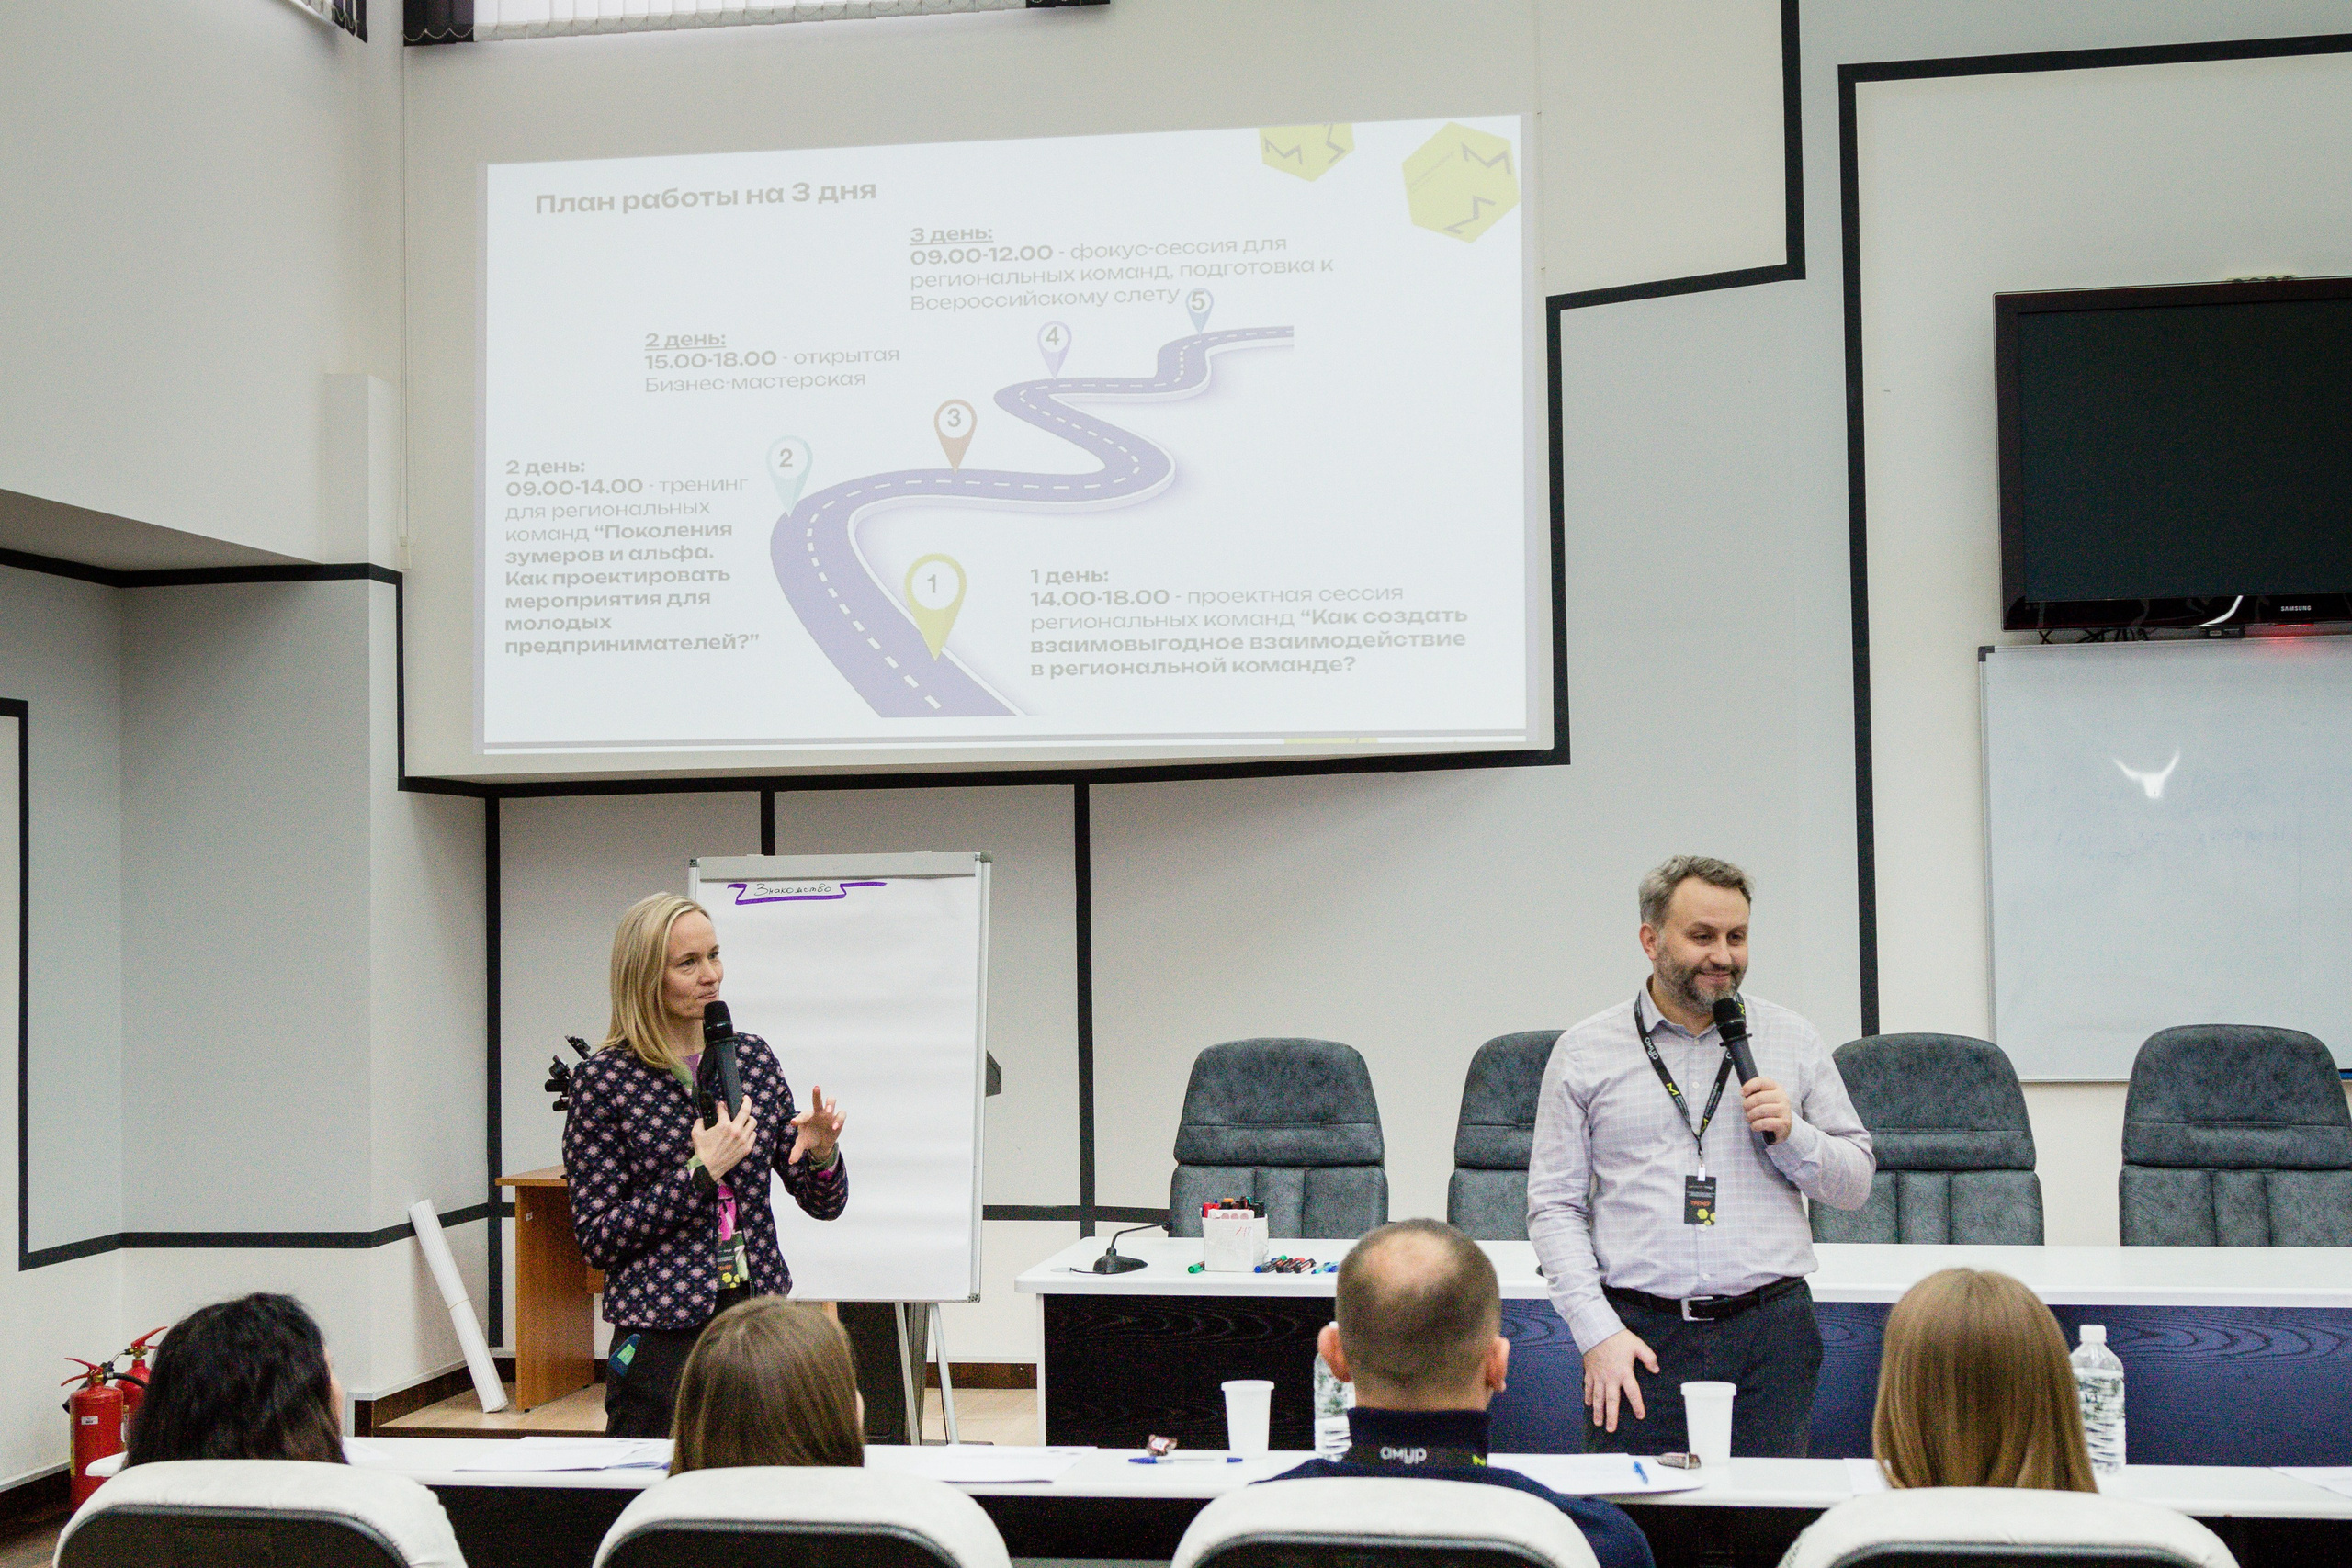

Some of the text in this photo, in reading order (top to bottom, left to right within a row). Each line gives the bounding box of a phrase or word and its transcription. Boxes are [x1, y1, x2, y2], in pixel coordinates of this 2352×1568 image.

[536, 181, 877, 215] План работы на 3 дня
[910, 227, 994, 246] 3 день:
[910, 244, 1054, 266] 09.00-12.00
[1069, 239, 1238, 261] фокус-сессия
[1242, 237, 1287, 254] для
[910, 259, 1333, 290] региональных команд, подготовка к
[910, 288, 1180, 312] Всероссийскому слету
[1191, 291, 1206, 311] 5
[644, 332, 728, 351] 2 день:
[1045, 325, 1060, 346] 4
[644, 349, 778, 370] 15.00-18.00
[793, 348, 900, 366] открытая
[645, 373, 865, 393] Бизнес-мастерская
[947, 407, 962, 428] 3
[505, 459, 585, 477] 2 день:
[779, 447, 794, 468] 2
[505, 478, 644, 498] 09.00-14.00
[661, 478, 749, 495] тренинг
[504, 502, 710, 521] для региональных
[505, 524, 733, 542] команд “Поколения
[505, 544, 714, 568] зумеров и альфа.
[505, 569, 731, 589] Как проектировать
[927, 573, 937, 593] 1
[1030, 568, 1109, 586] 1 день:
[504, 591, 711, 612] мероприятия для
[1030, 588, 1170, 607] 14.00-18.00
[1187, 588, 1313, 607] проектная
[1318, 586, 1403, 603] сессия
[504, 617, 612, 632] молодых
[1031, 608, 1468, 633] региональных команд “Как создать
[504, 633, 760, 658] предпринимателей?”
[1030, 630, 1466, 654] взаимовыгодное взаимодействие
[1030, 655, 1357, 681] в региональной команде?
[753, 883, 831, 897] Знакомство
